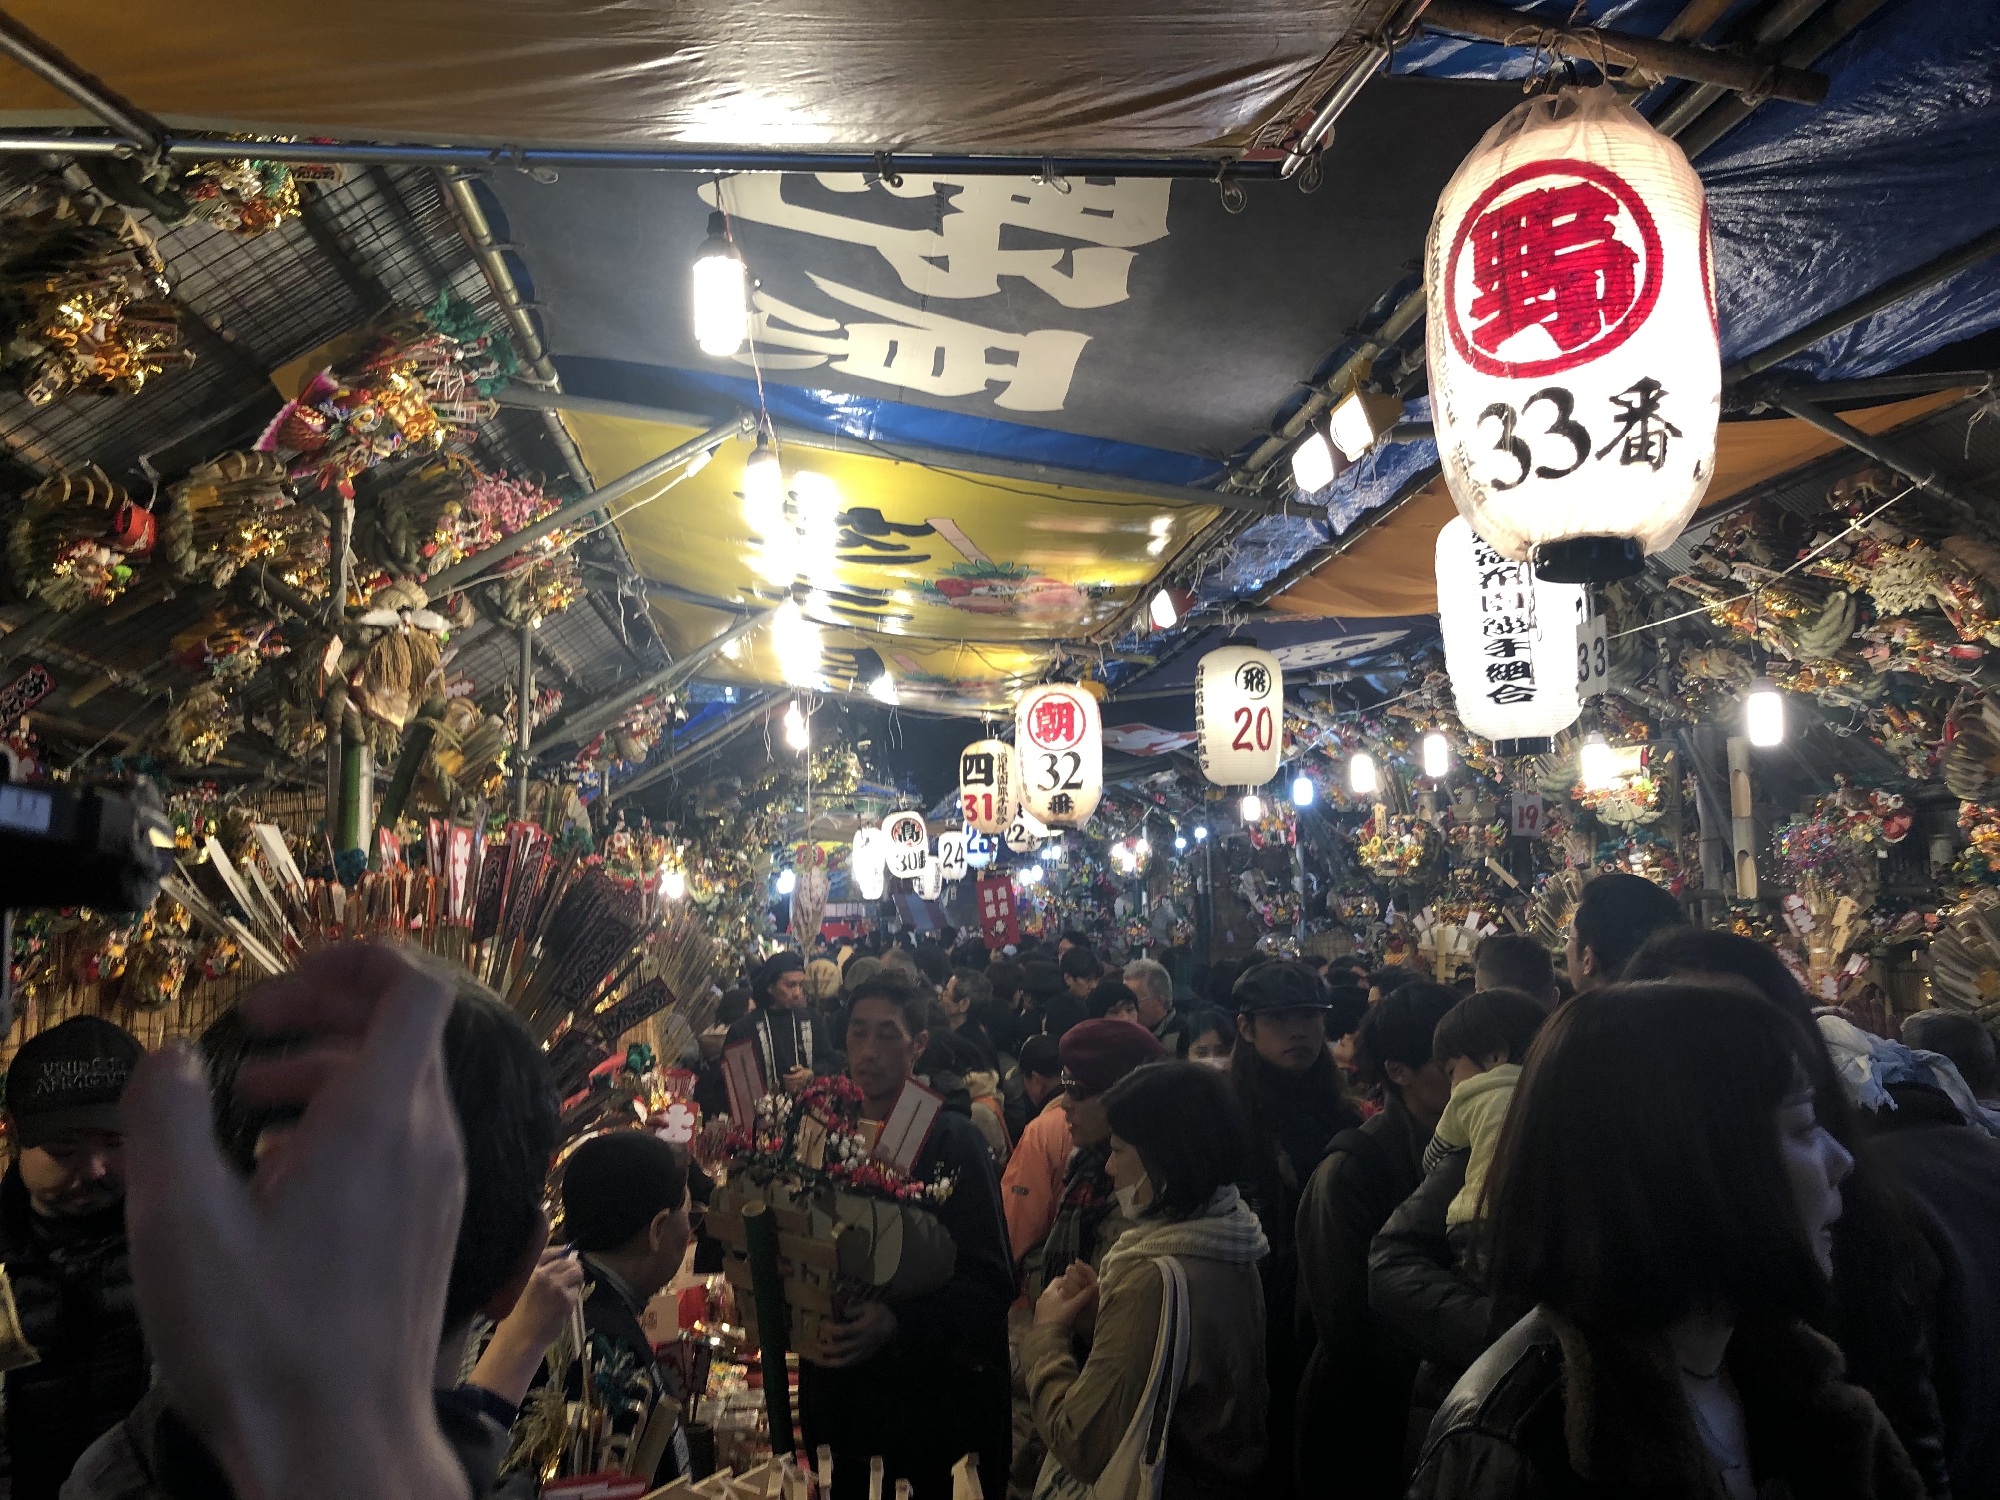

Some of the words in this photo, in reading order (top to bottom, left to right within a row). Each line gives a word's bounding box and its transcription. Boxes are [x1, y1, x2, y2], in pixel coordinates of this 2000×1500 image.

[1475, 376, 1683, 492] 33番
[1577, 636, 1606, 683] 33
[1034, 701, 1075, 743] 朝
[1232, 706, 1273, 752] 20
[962, 752, 994, 787] 四
[1037, 750, 1084, 792] 32
[963, 793, 993, 822] 31
[1517, 804, 1539, 830] 19
[943, 841, 965, 869] 24
